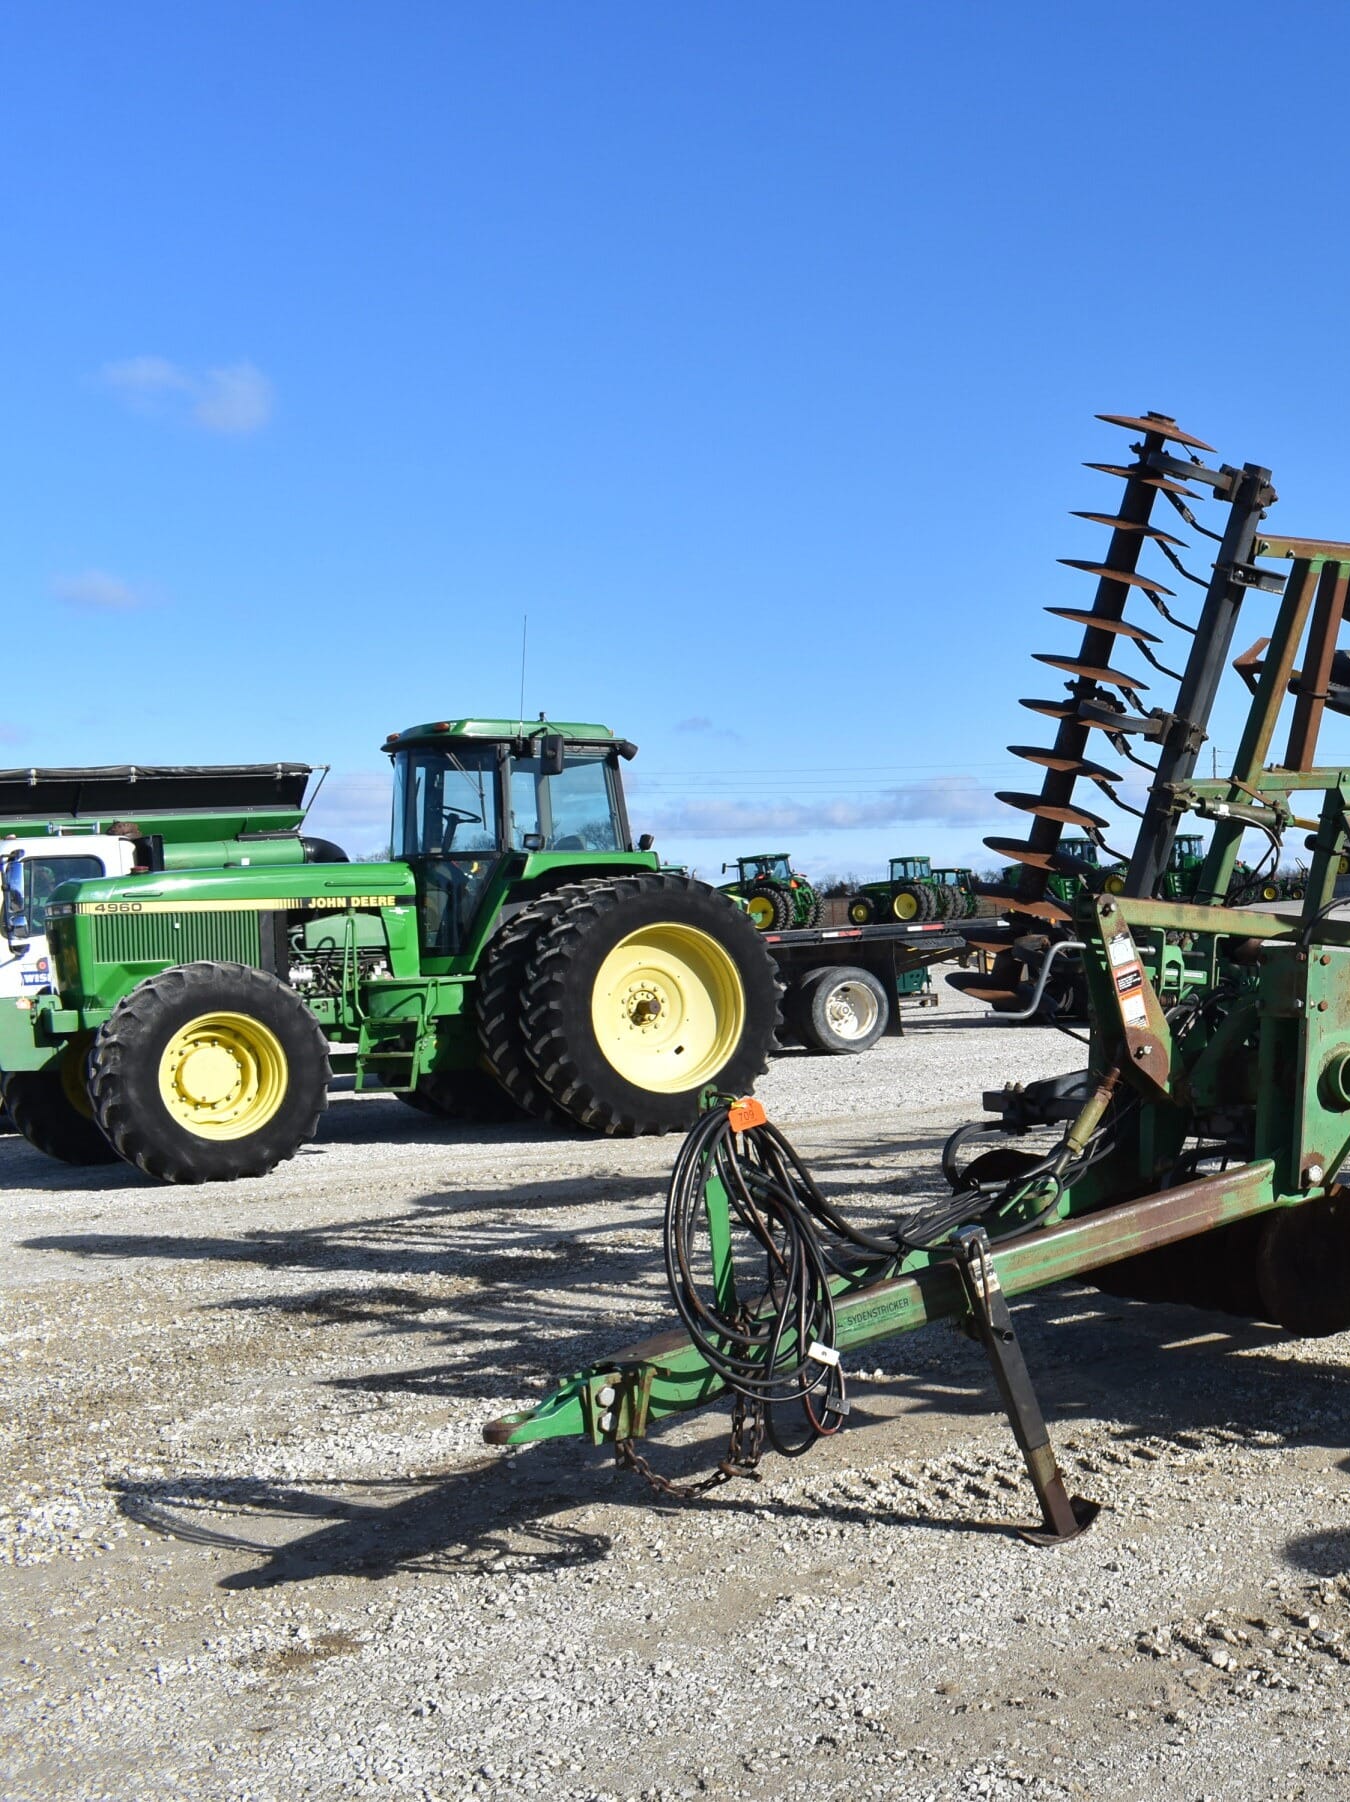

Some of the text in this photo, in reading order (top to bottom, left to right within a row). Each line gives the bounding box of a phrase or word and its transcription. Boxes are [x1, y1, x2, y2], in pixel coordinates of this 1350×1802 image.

[94, 903, 143, 912] 4960
[308, 895, 396, 909] JOHN DEERE
[737, 1109, 755, 1121] 709
[847, 1298, 910, 1327] SYDENSTRICKER
